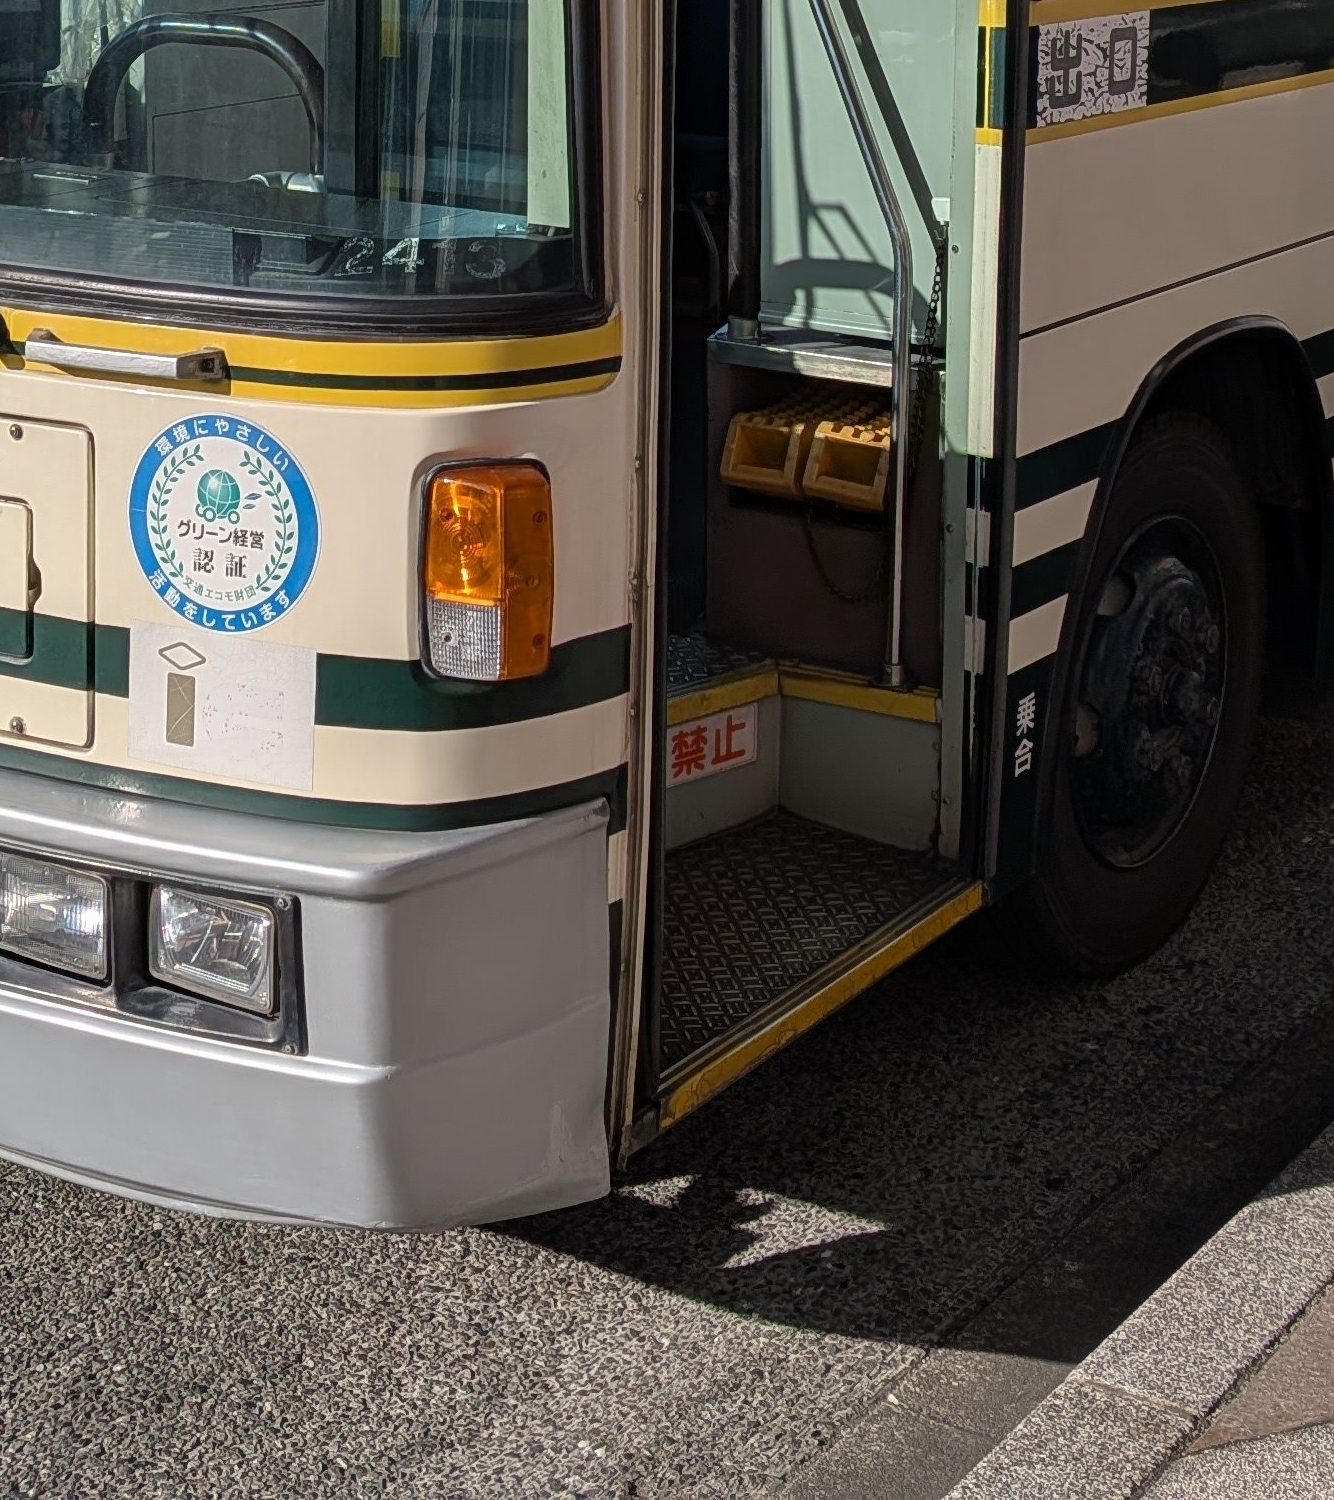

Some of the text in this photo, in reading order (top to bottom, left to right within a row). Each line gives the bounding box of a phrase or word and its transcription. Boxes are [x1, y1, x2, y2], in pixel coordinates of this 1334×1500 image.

[1048, 27, 1138, 110] 出口
[154, 418, 289, 472] 環境にやさしい
[177, 518, 265, 550] グリーン経営
[192, 546, 247, 578] 認証
[148, 568, 293, 630] 活動をしています
[183, 575, 257, 602] 交通エコモ財団
[671, 714, 747, 779] 禁止
[1015, 691, 1036, 778] 乗合
